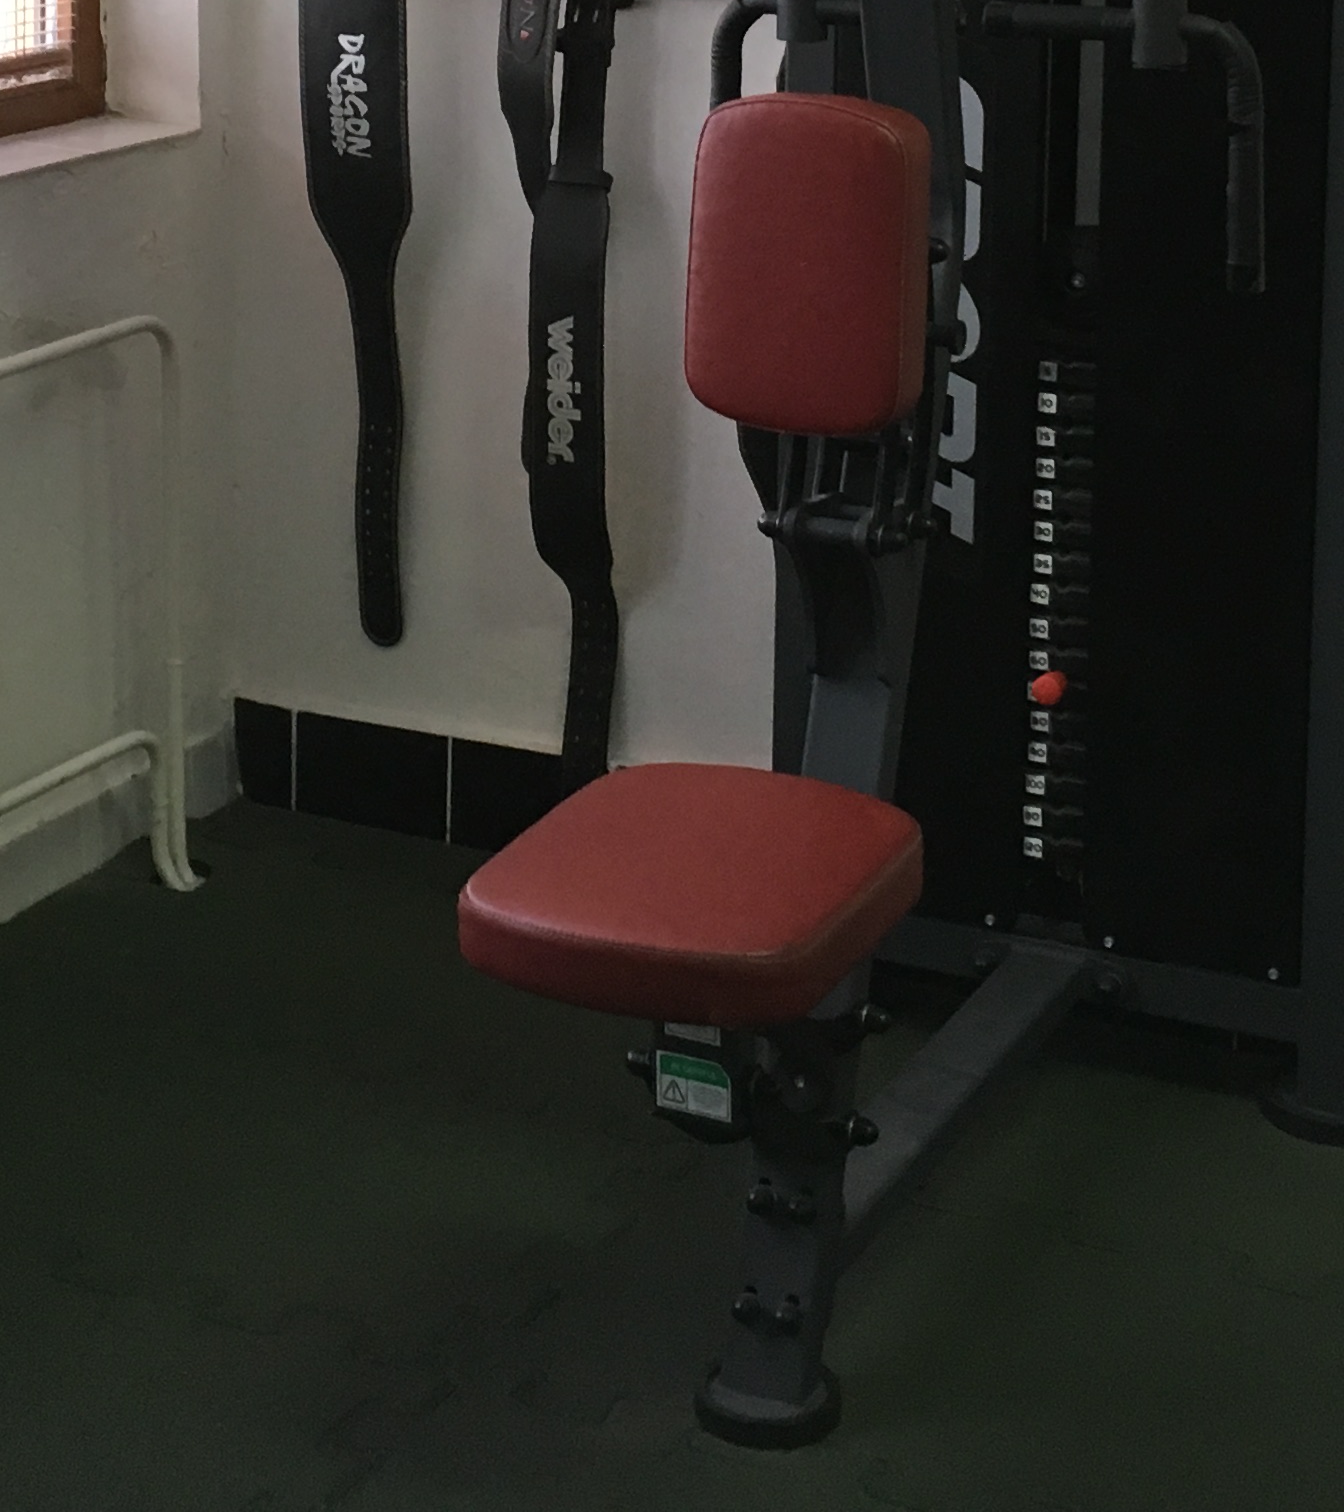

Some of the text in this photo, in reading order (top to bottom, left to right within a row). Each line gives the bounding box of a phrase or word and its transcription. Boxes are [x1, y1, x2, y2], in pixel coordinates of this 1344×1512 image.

[330, 33, 373, 159] DRAGON
[547, 314, 582, 463] weider
[1032, 587, 1047, 599] 40
